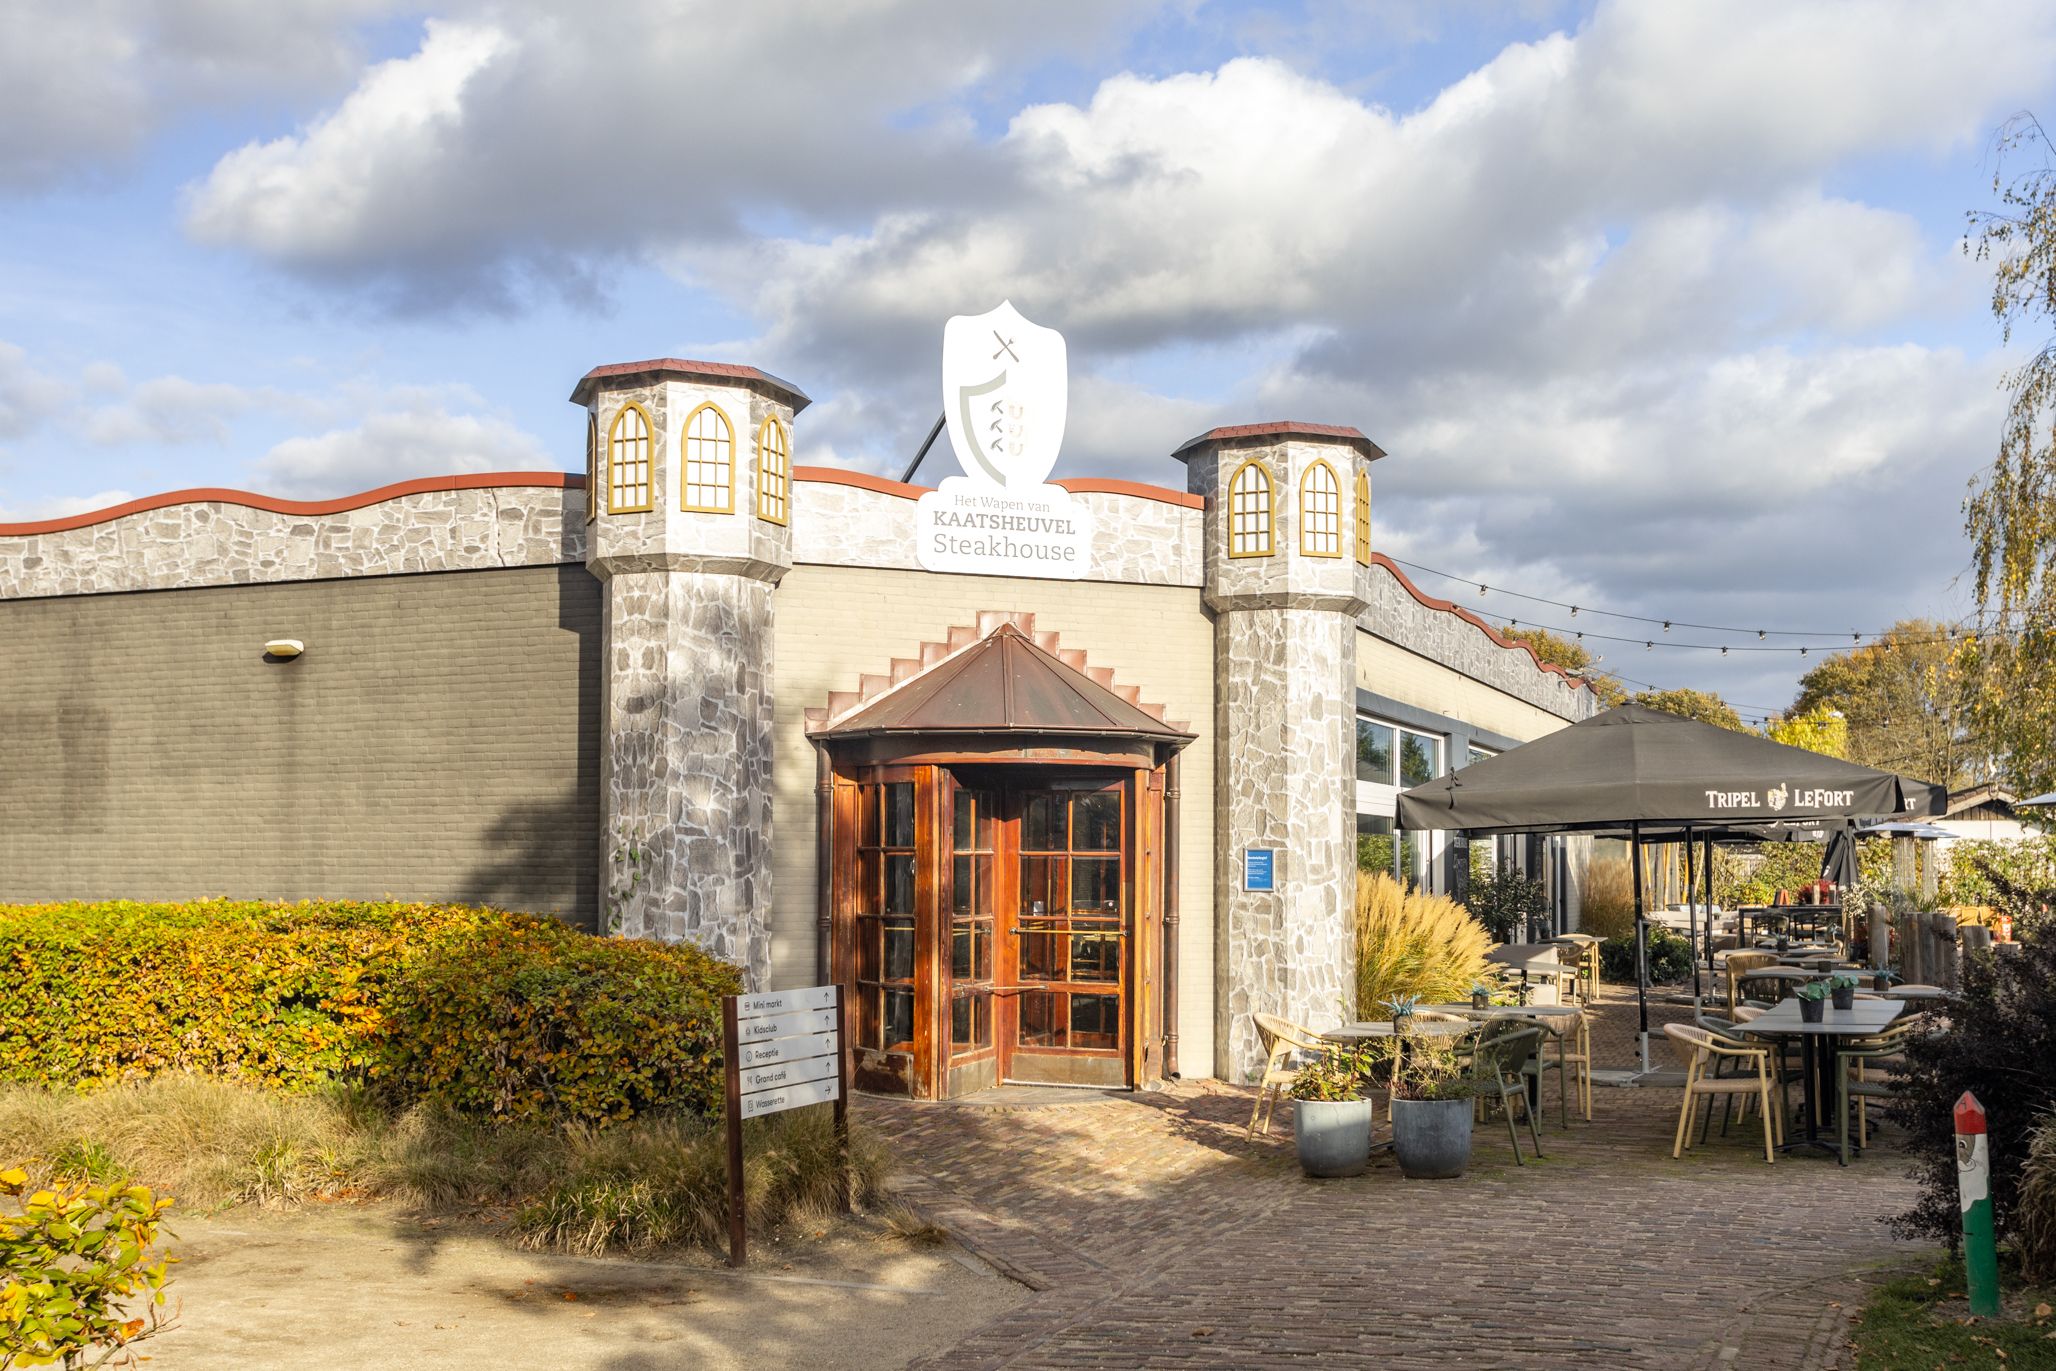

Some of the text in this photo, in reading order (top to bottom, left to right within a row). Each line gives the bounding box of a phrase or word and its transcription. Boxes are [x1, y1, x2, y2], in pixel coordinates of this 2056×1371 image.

[954, 494, 1050, 513] Het Wapen van
[933, 510, 1076, 535] KAATSHEUVEL
[933, 533, 1075, 562] Steakhouse
[753, 999, 782, 1010] Mini markt
[753, 1024, 778, 1034] Kidsclub
[755, 1048, 779, 1060] Receptie
[755, 1070, 787, 1084] Grand café
[756, 1095, 785, 1109] Wasserette
